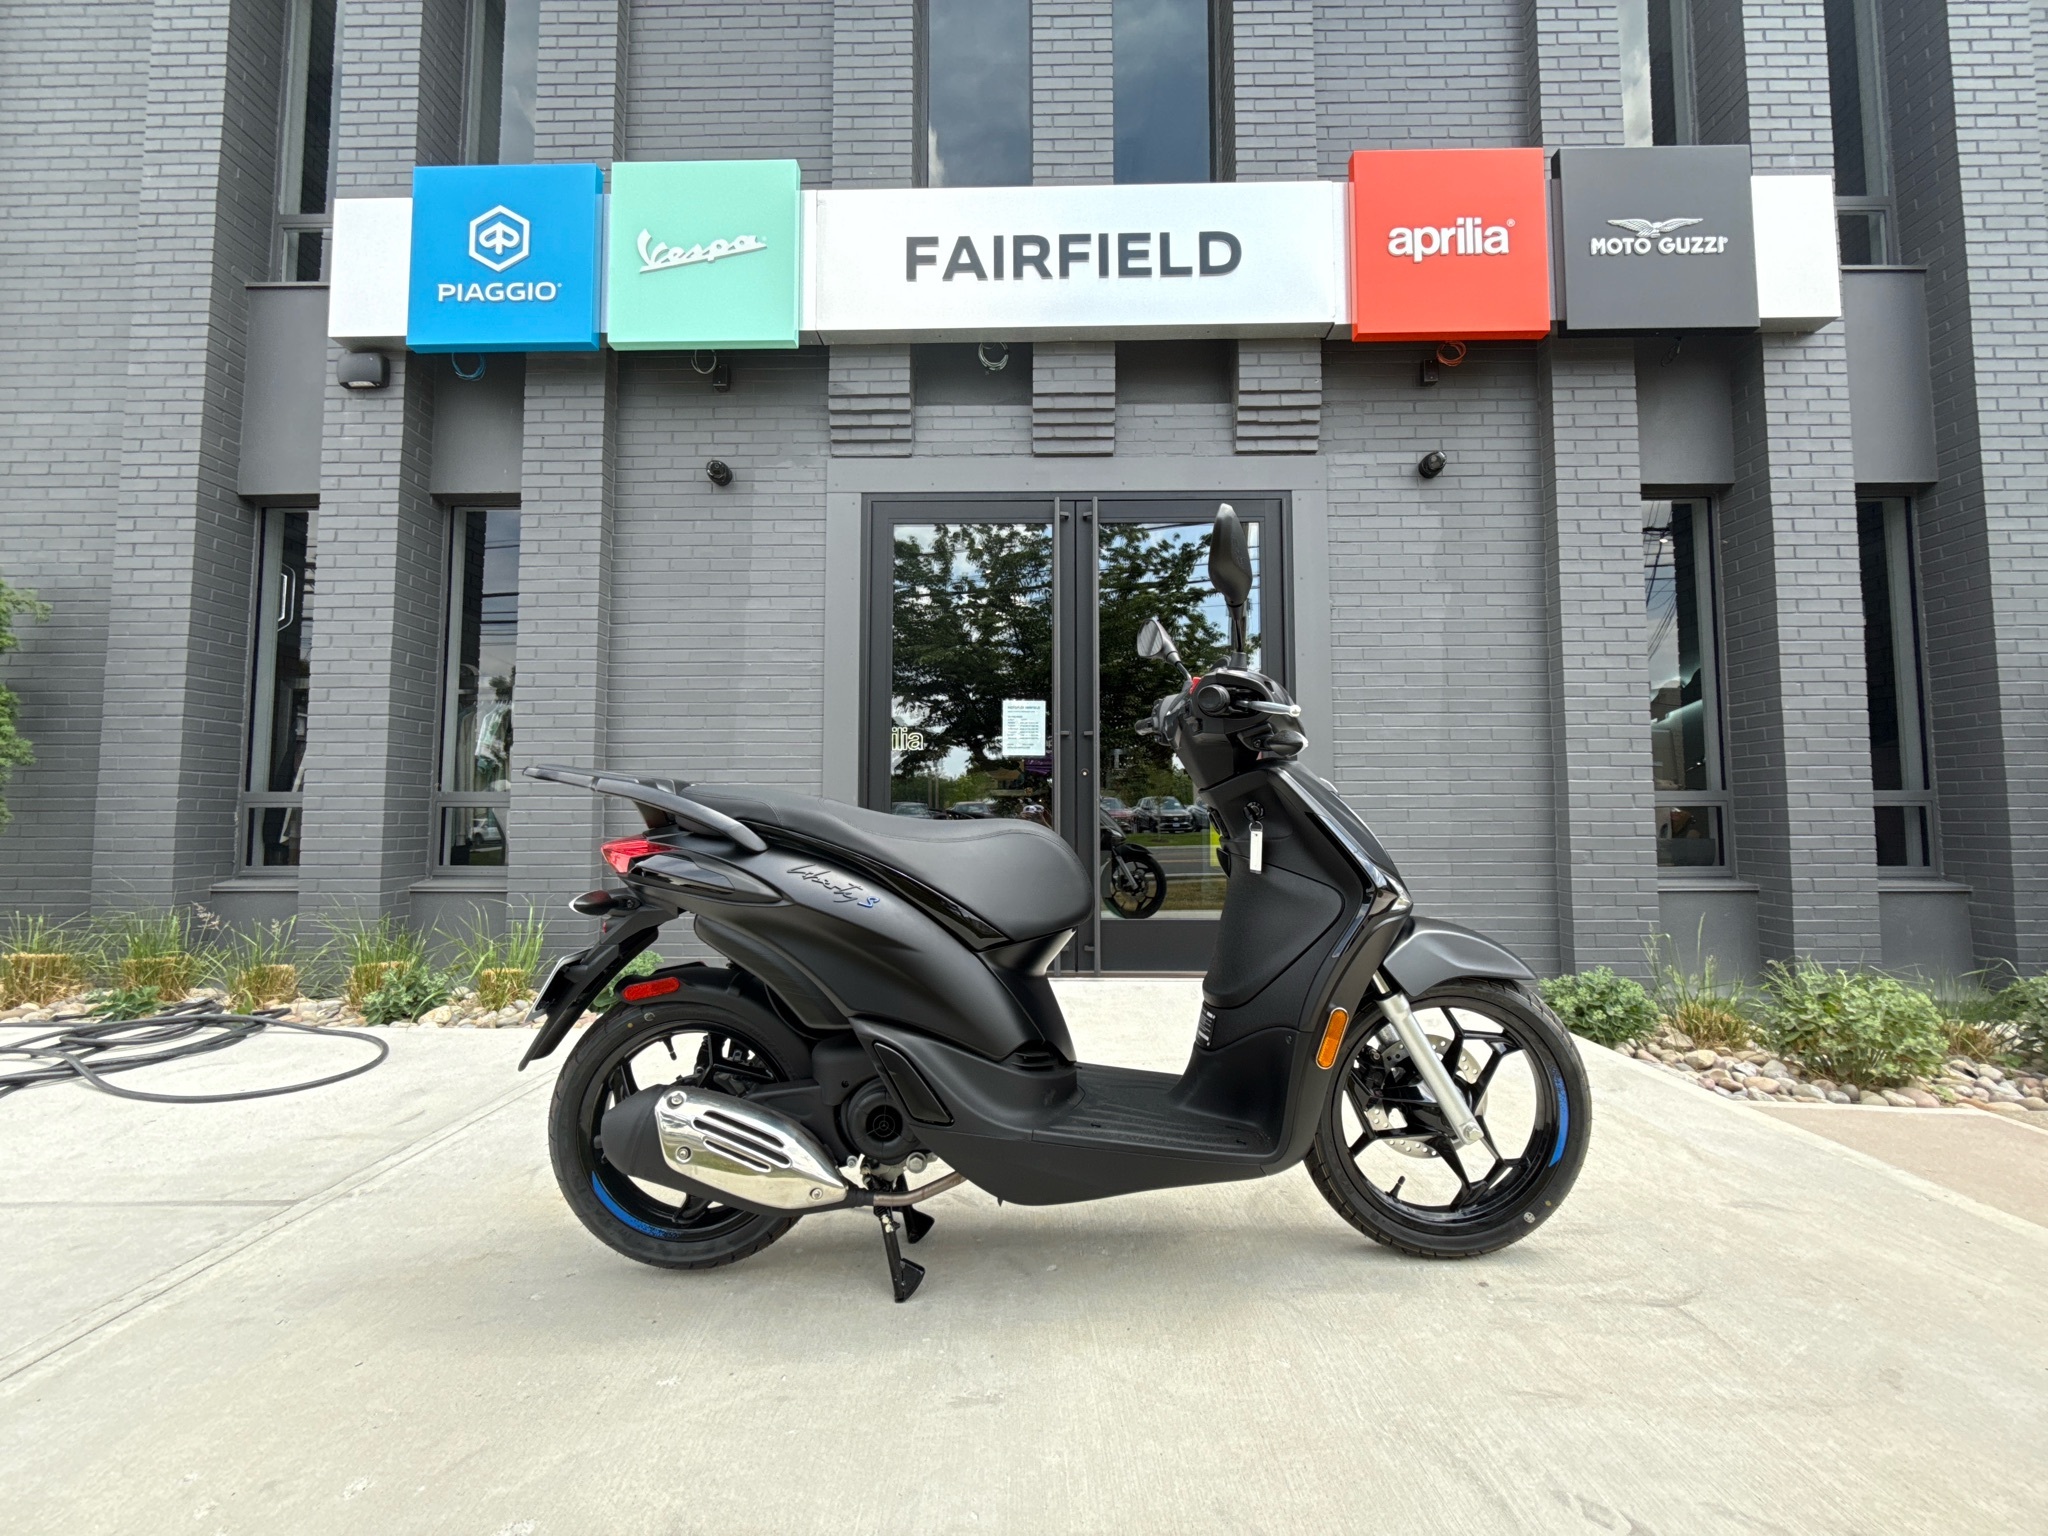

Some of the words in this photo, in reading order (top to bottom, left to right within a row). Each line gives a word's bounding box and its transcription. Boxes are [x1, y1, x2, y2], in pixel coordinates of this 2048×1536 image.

[637, 228, 767, 274] Vespa
[906, 231, 1242, 280] FAIRFIELD
[1388, 217, 1510, 263] aprilia
[1590, 237, 1652, 255] MOTO
[1658, 236, 1726, 254] GUZZI
[437, 281, 557, 302] PIAGGIO
